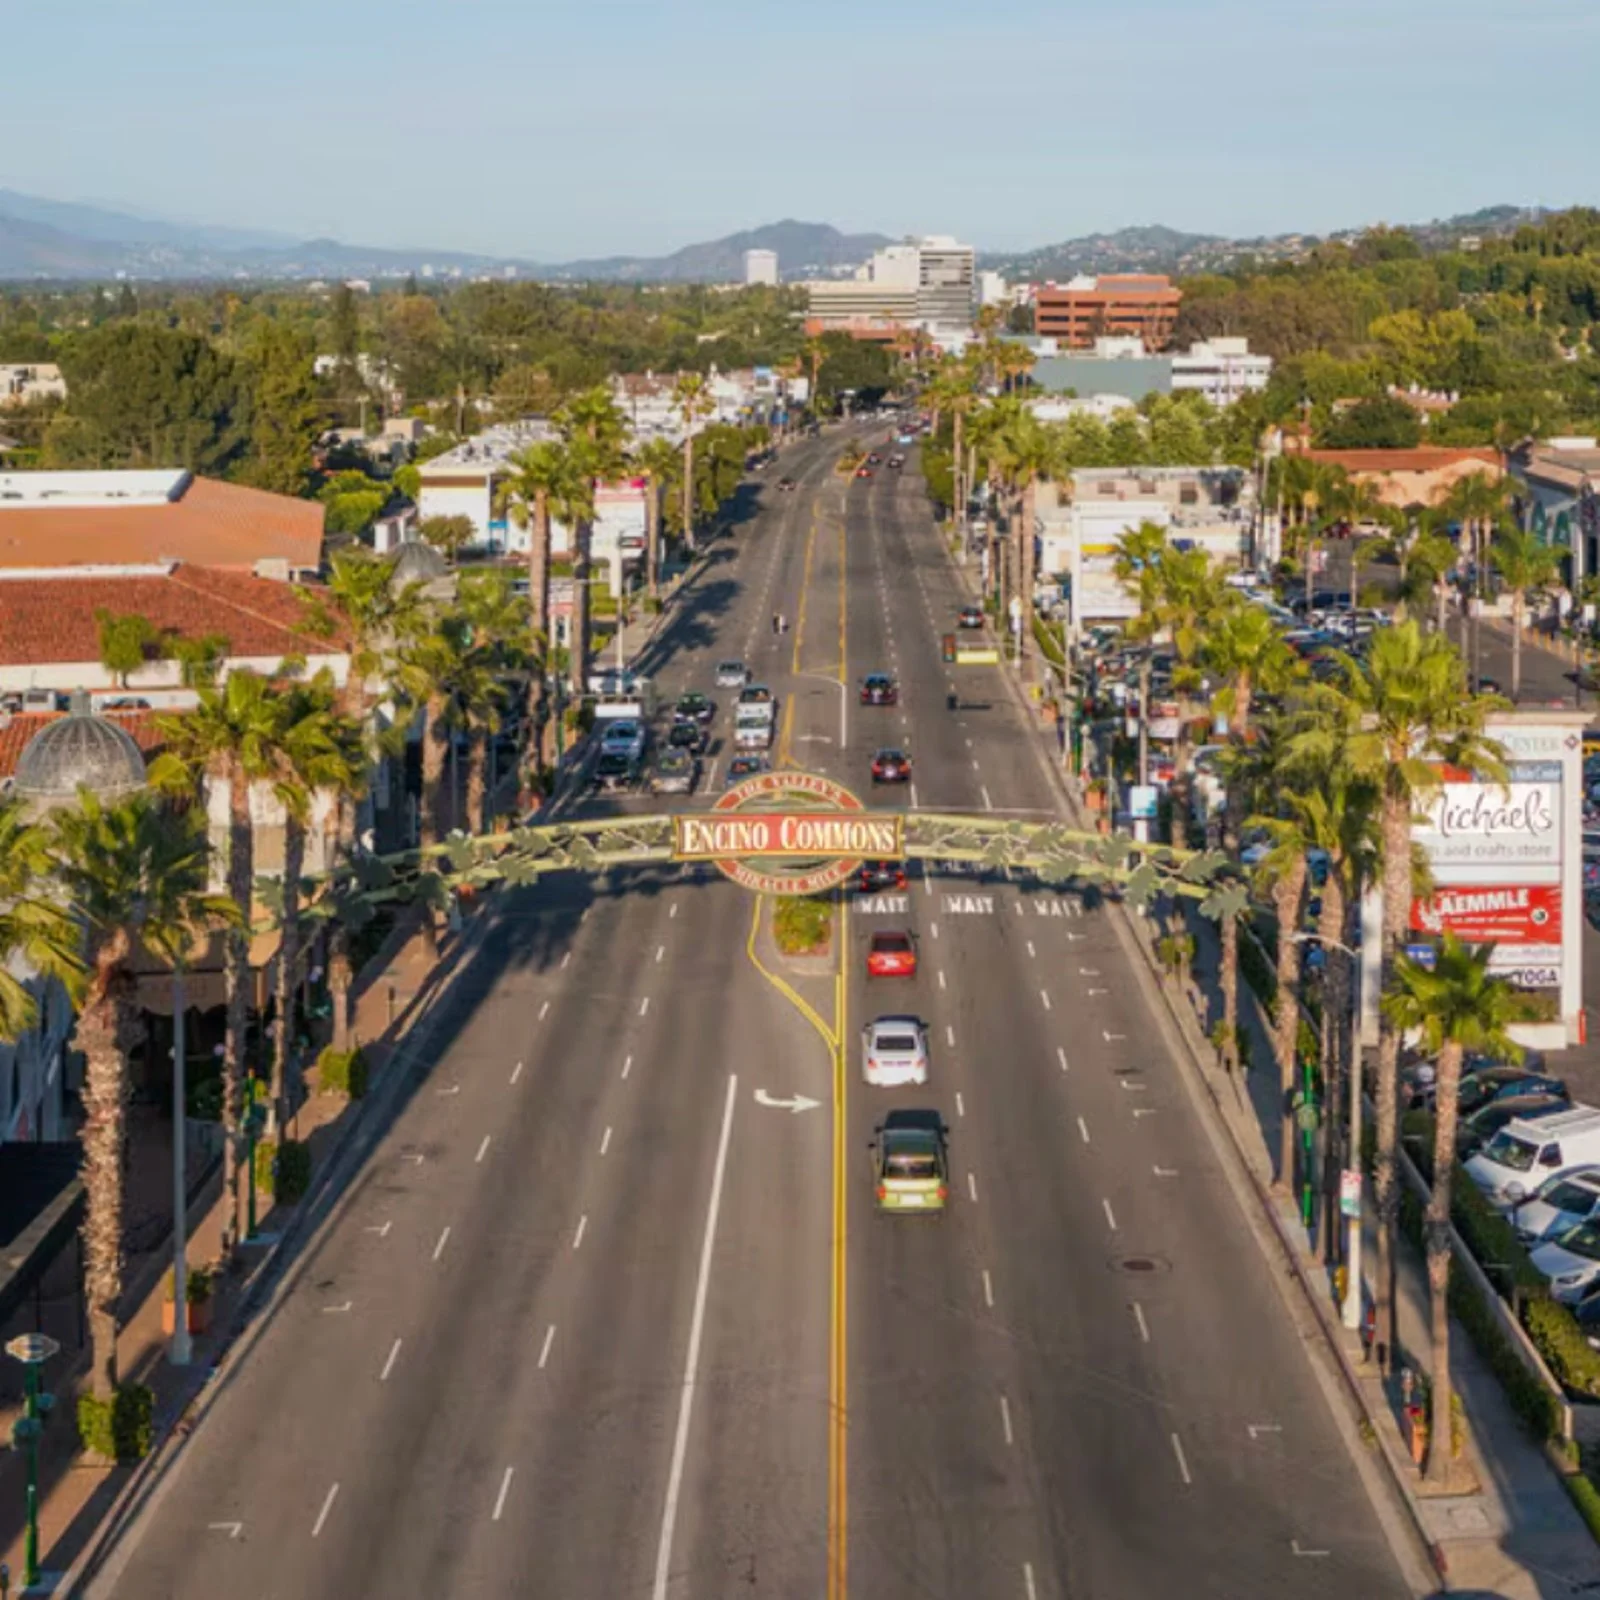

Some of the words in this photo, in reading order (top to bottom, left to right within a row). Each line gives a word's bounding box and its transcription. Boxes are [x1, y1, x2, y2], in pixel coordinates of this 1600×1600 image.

[683, 819, 769, 852] ENCINO
[779, 815, 895, 851] COMMONS
[1444, 843, 1471, 856] and
[1518, 844, 1552, 856] store
